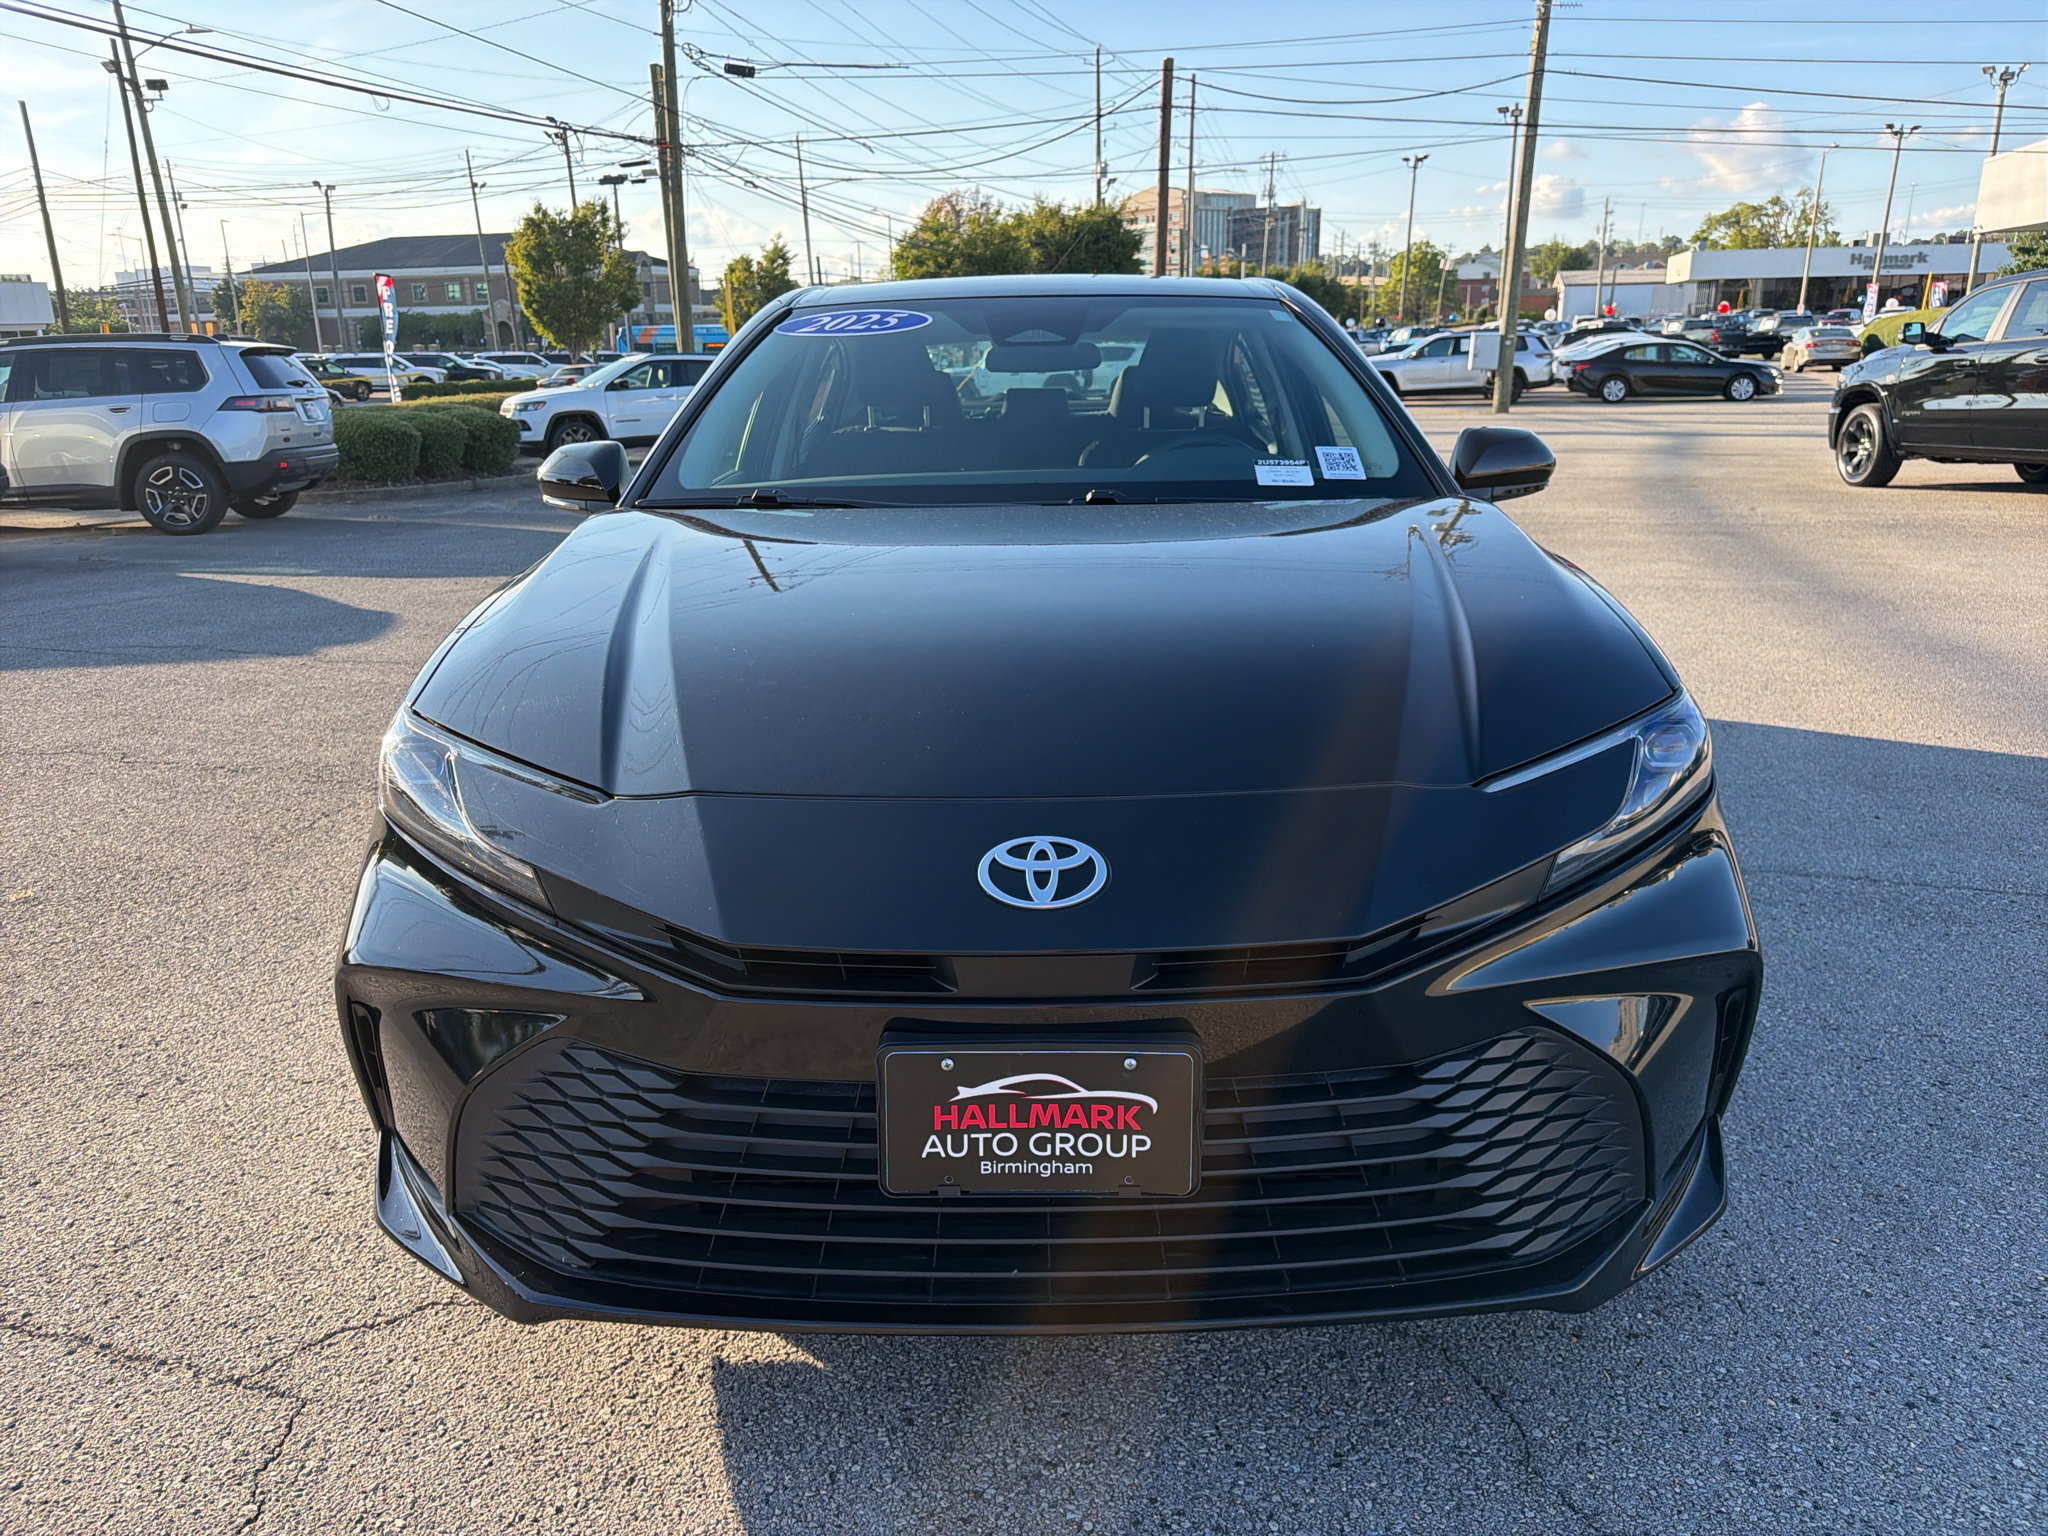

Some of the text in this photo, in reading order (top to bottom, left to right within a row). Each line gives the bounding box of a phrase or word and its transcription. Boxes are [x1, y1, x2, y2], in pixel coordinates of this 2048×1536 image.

[1850, 252, 1929, 265] Halmark
[795, 313, 909, 333] 2025
[933, 1103, 1142, 1130] HALLMARK
[921, 1132, 1152, 1158] AUTO GROUP
[980, 1160, 1093, 1177] Birmingham
